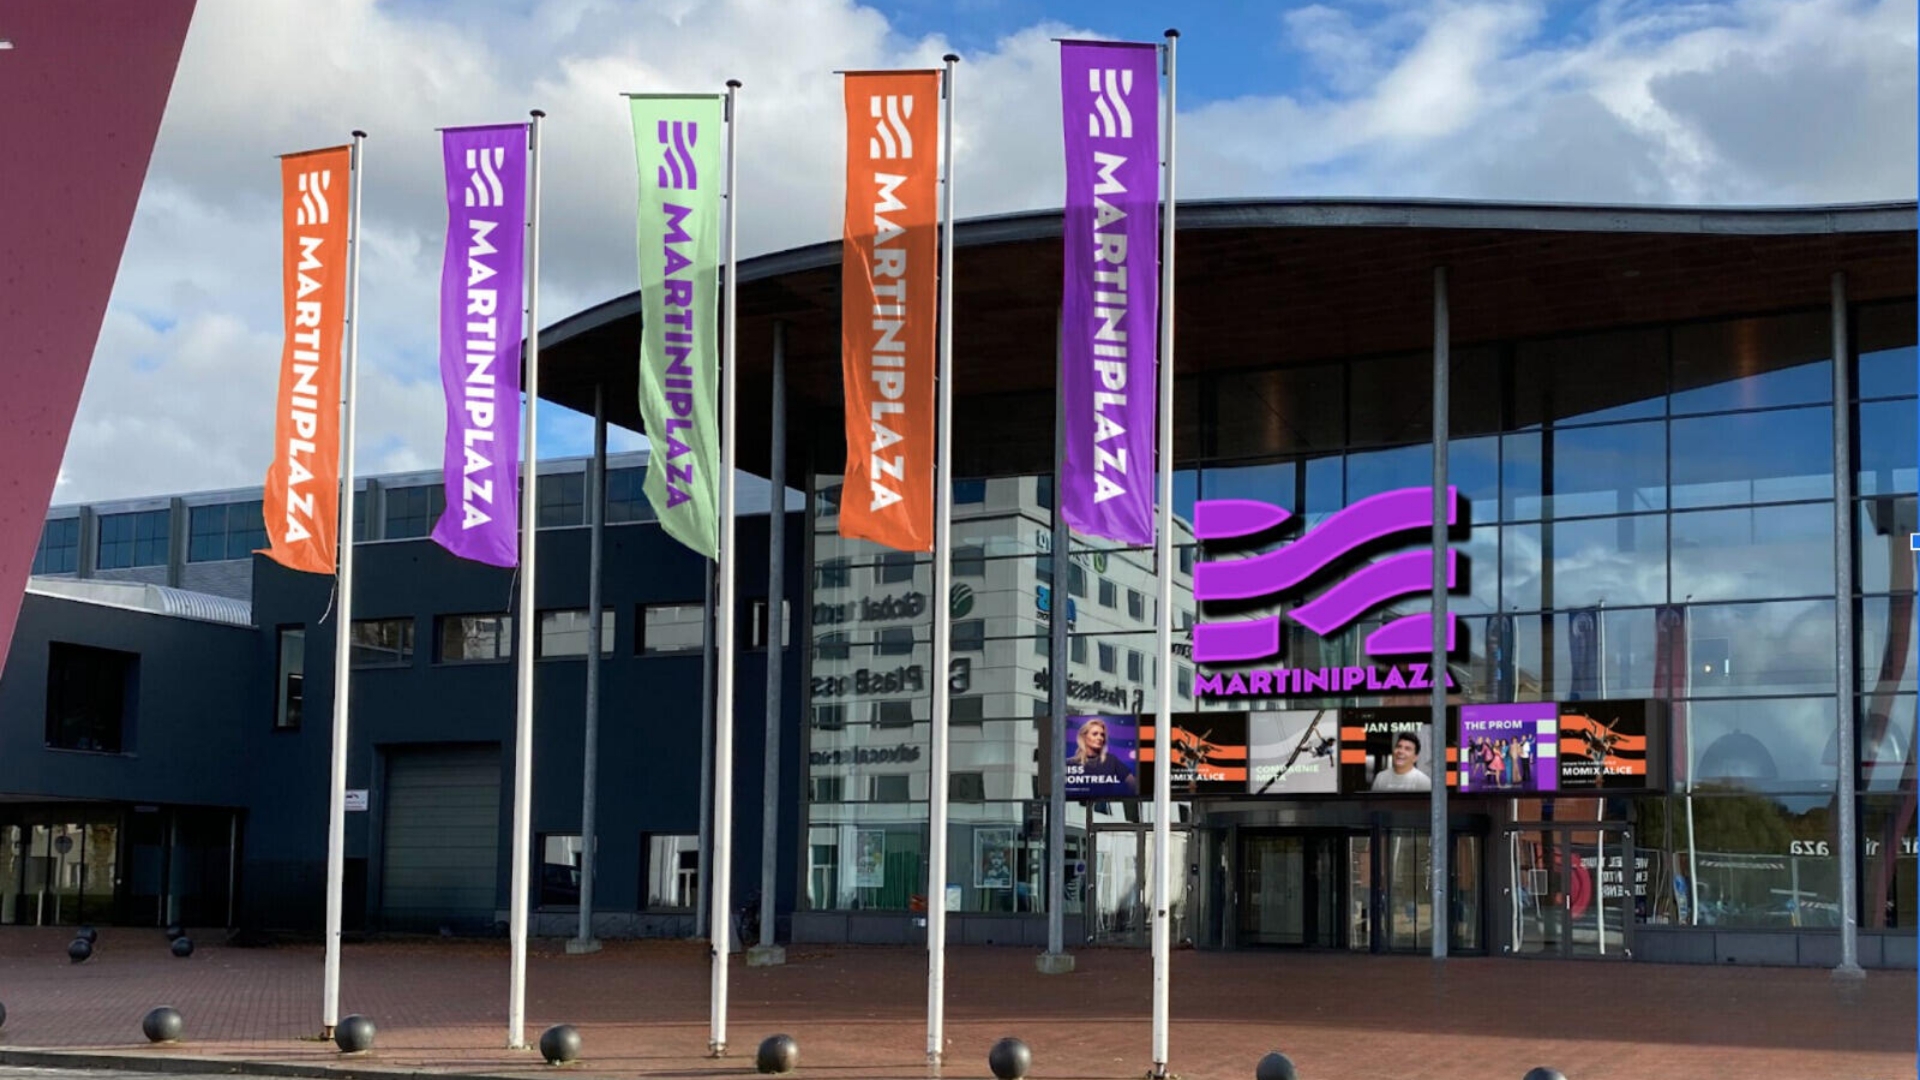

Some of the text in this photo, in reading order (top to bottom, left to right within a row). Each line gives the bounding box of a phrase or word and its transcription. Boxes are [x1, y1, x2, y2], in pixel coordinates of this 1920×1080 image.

[1093, 151, 1128, 505] MARTINIPLAZA
[868, 172, 907, 512] MARTINIPLAZA
[662, 203, 693, 509] MARTINIPLAZA
[462, 219, 498, 530] MARTINIPLAZA
[285, 236, 323, 543] MARTINIPLAZA
[1362, 721, 1423, 733] JAN SMIT
[1464, 720, 1522, 731] THE PROM
[1067, 766, 1085, 774] ISS
[1562, 766, 1632, 776] MOMIX ALICE
[1066, 774, 1120, 784] ONTREAL
[1196, 772, 1225, 781] ALICE
